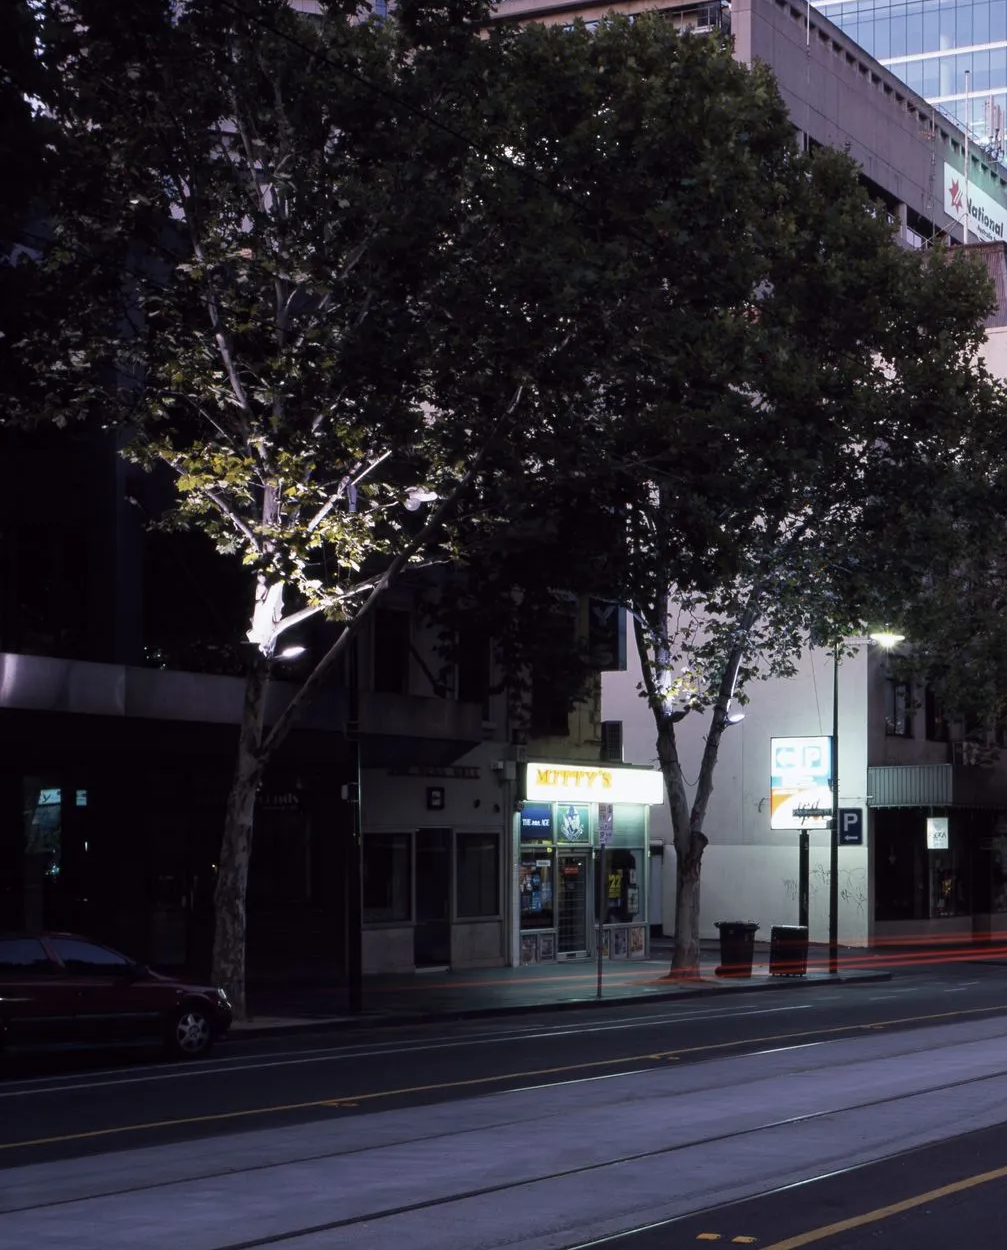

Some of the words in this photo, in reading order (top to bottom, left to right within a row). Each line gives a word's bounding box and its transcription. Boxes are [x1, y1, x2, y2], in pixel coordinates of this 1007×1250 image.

[966, 198, 1004, 239] National
[535, 767, 613, 791] MITTY'S
[844, 812, 857, 832] P
